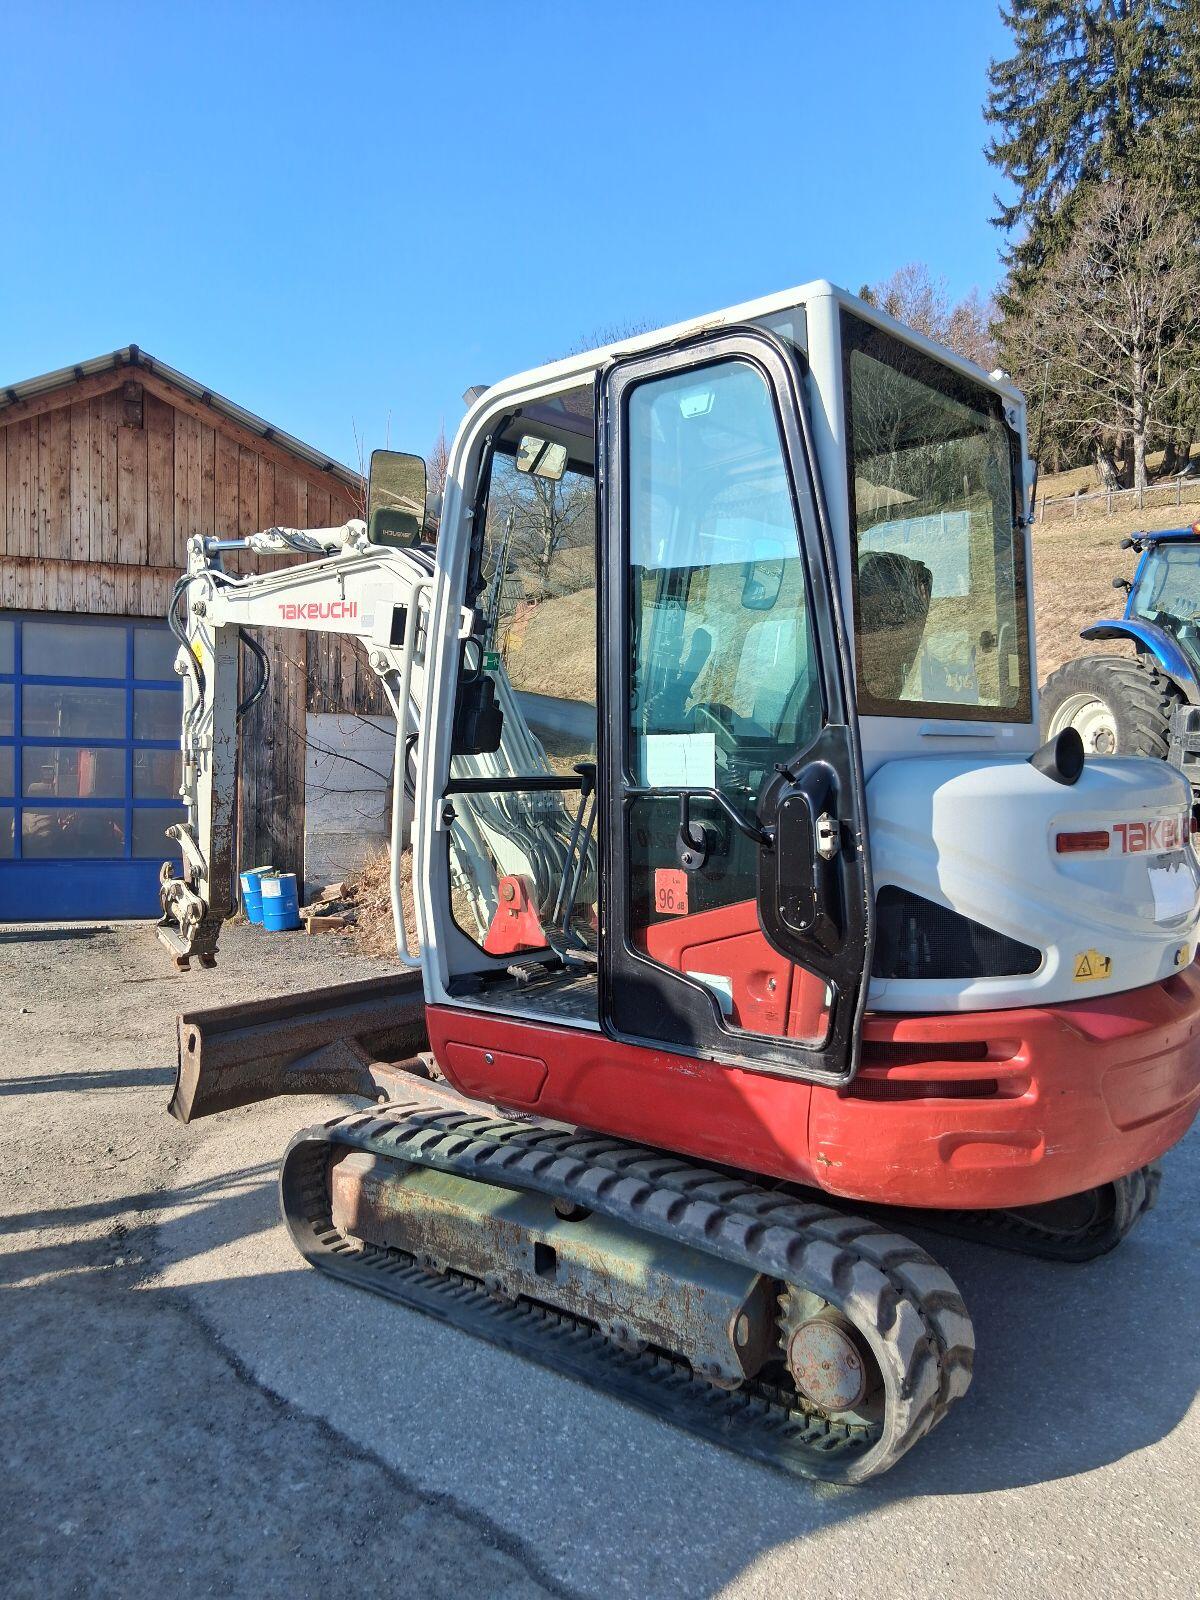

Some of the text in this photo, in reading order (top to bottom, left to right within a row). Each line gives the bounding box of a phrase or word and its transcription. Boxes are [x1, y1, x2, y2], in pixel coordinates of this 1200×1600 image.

[279, 602, 357, 619] TAKEUCHI
[659, 888, 685, 910] 96 dB
